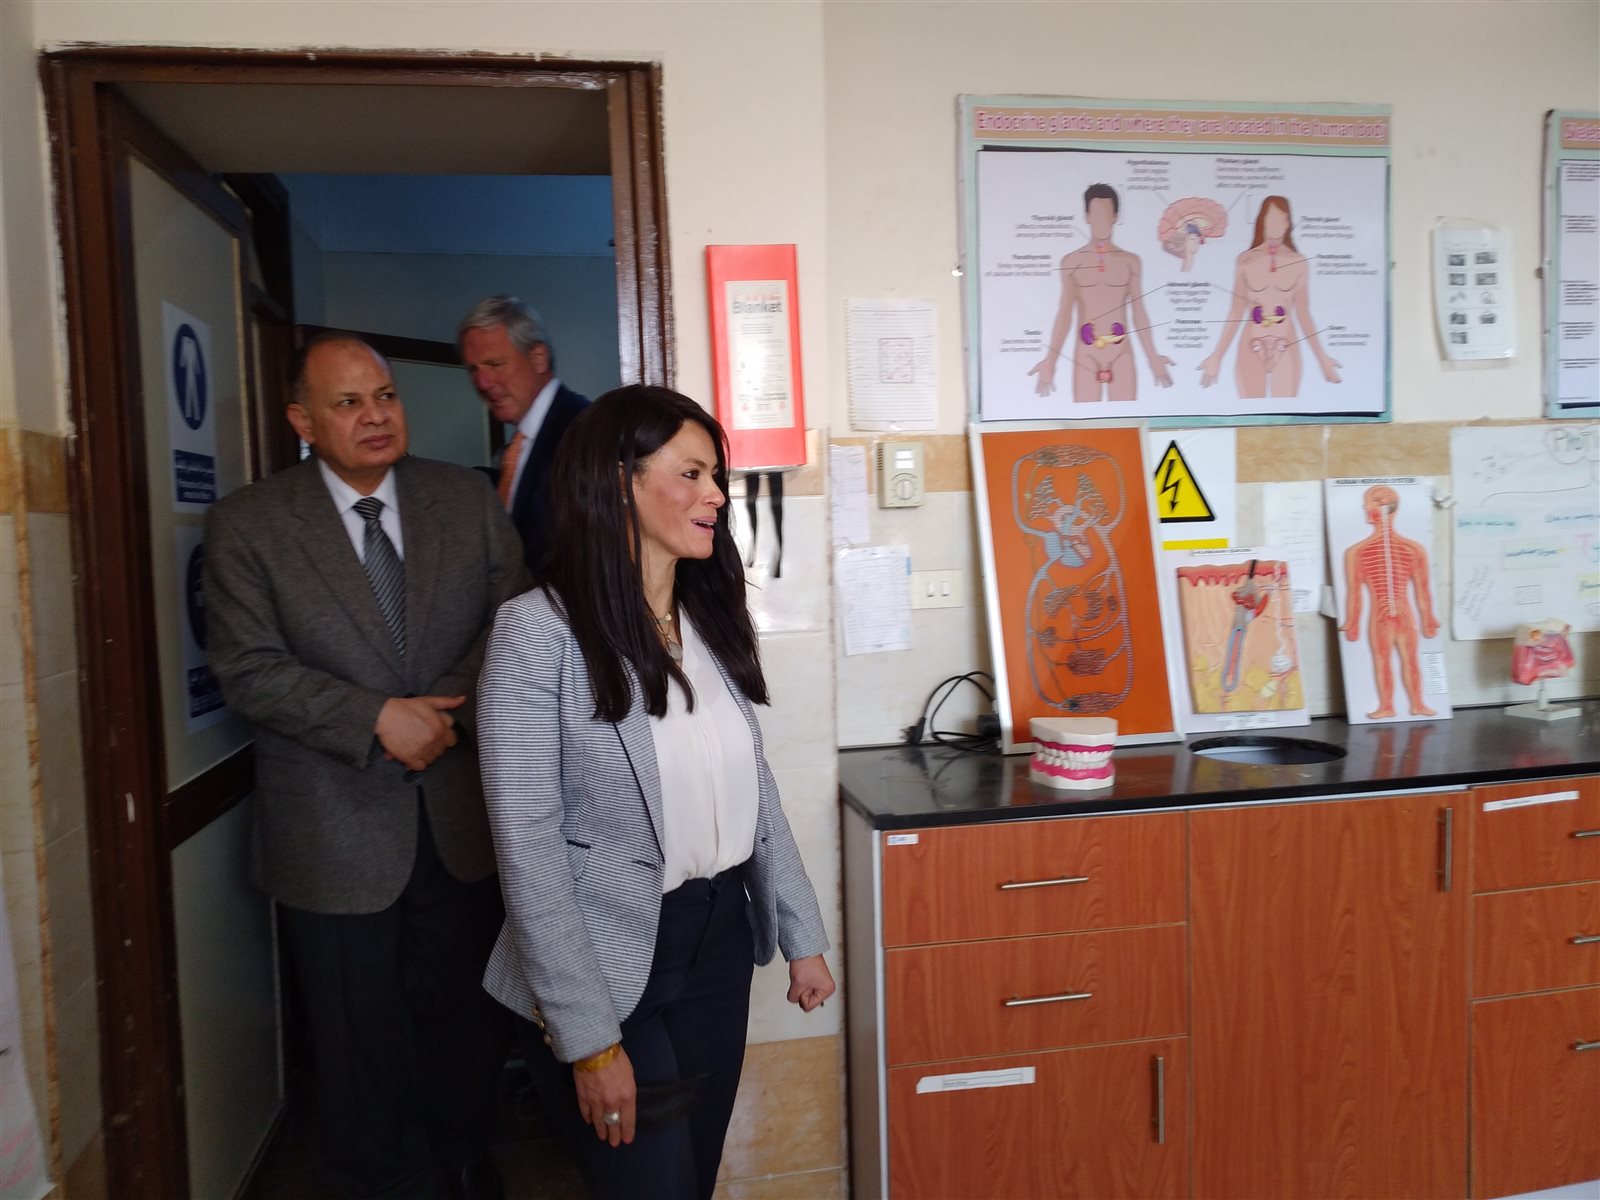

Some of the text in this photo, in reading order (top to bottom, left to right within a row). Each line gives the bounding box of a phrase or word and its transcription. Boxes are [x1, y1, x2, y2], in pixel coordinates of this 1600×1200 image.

[977, 111, 1388, 141] Endocrine glands and where they are located in the human body
[732, 300, 783, 314] Blanket
